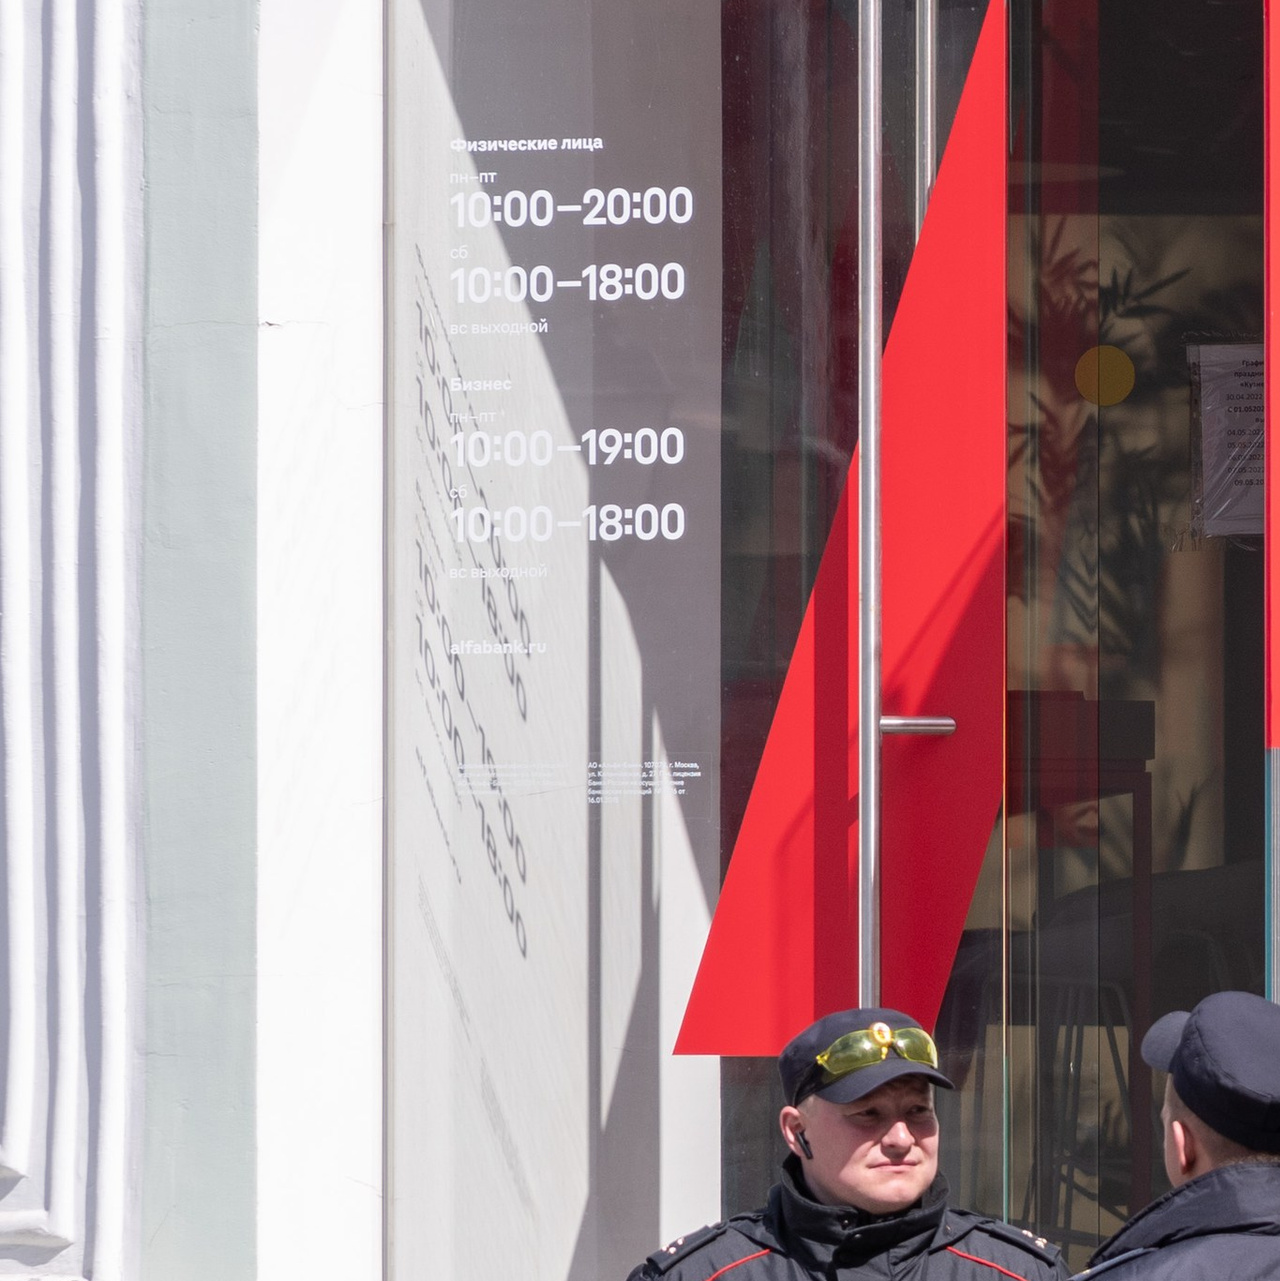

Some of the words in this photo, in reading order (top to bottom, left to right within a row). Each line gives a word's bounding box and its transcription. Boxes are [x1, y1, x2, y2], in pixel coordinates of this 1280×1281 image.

[450, 136, 558, 153] Физические
[561, 135, 604, 152] лица
[450, 245, 469, 260] сб
[450, 324, 469, 335] вс
[471, 319, 549, 336] выходной
[450, 377, 512, 392] Бизнес
[449, 485, 468, 499] сб
[450, 567, 469, 579] вс
[471, 563, 548, 580] выходной
[450, 639, 547, 655] alfabank.ru
